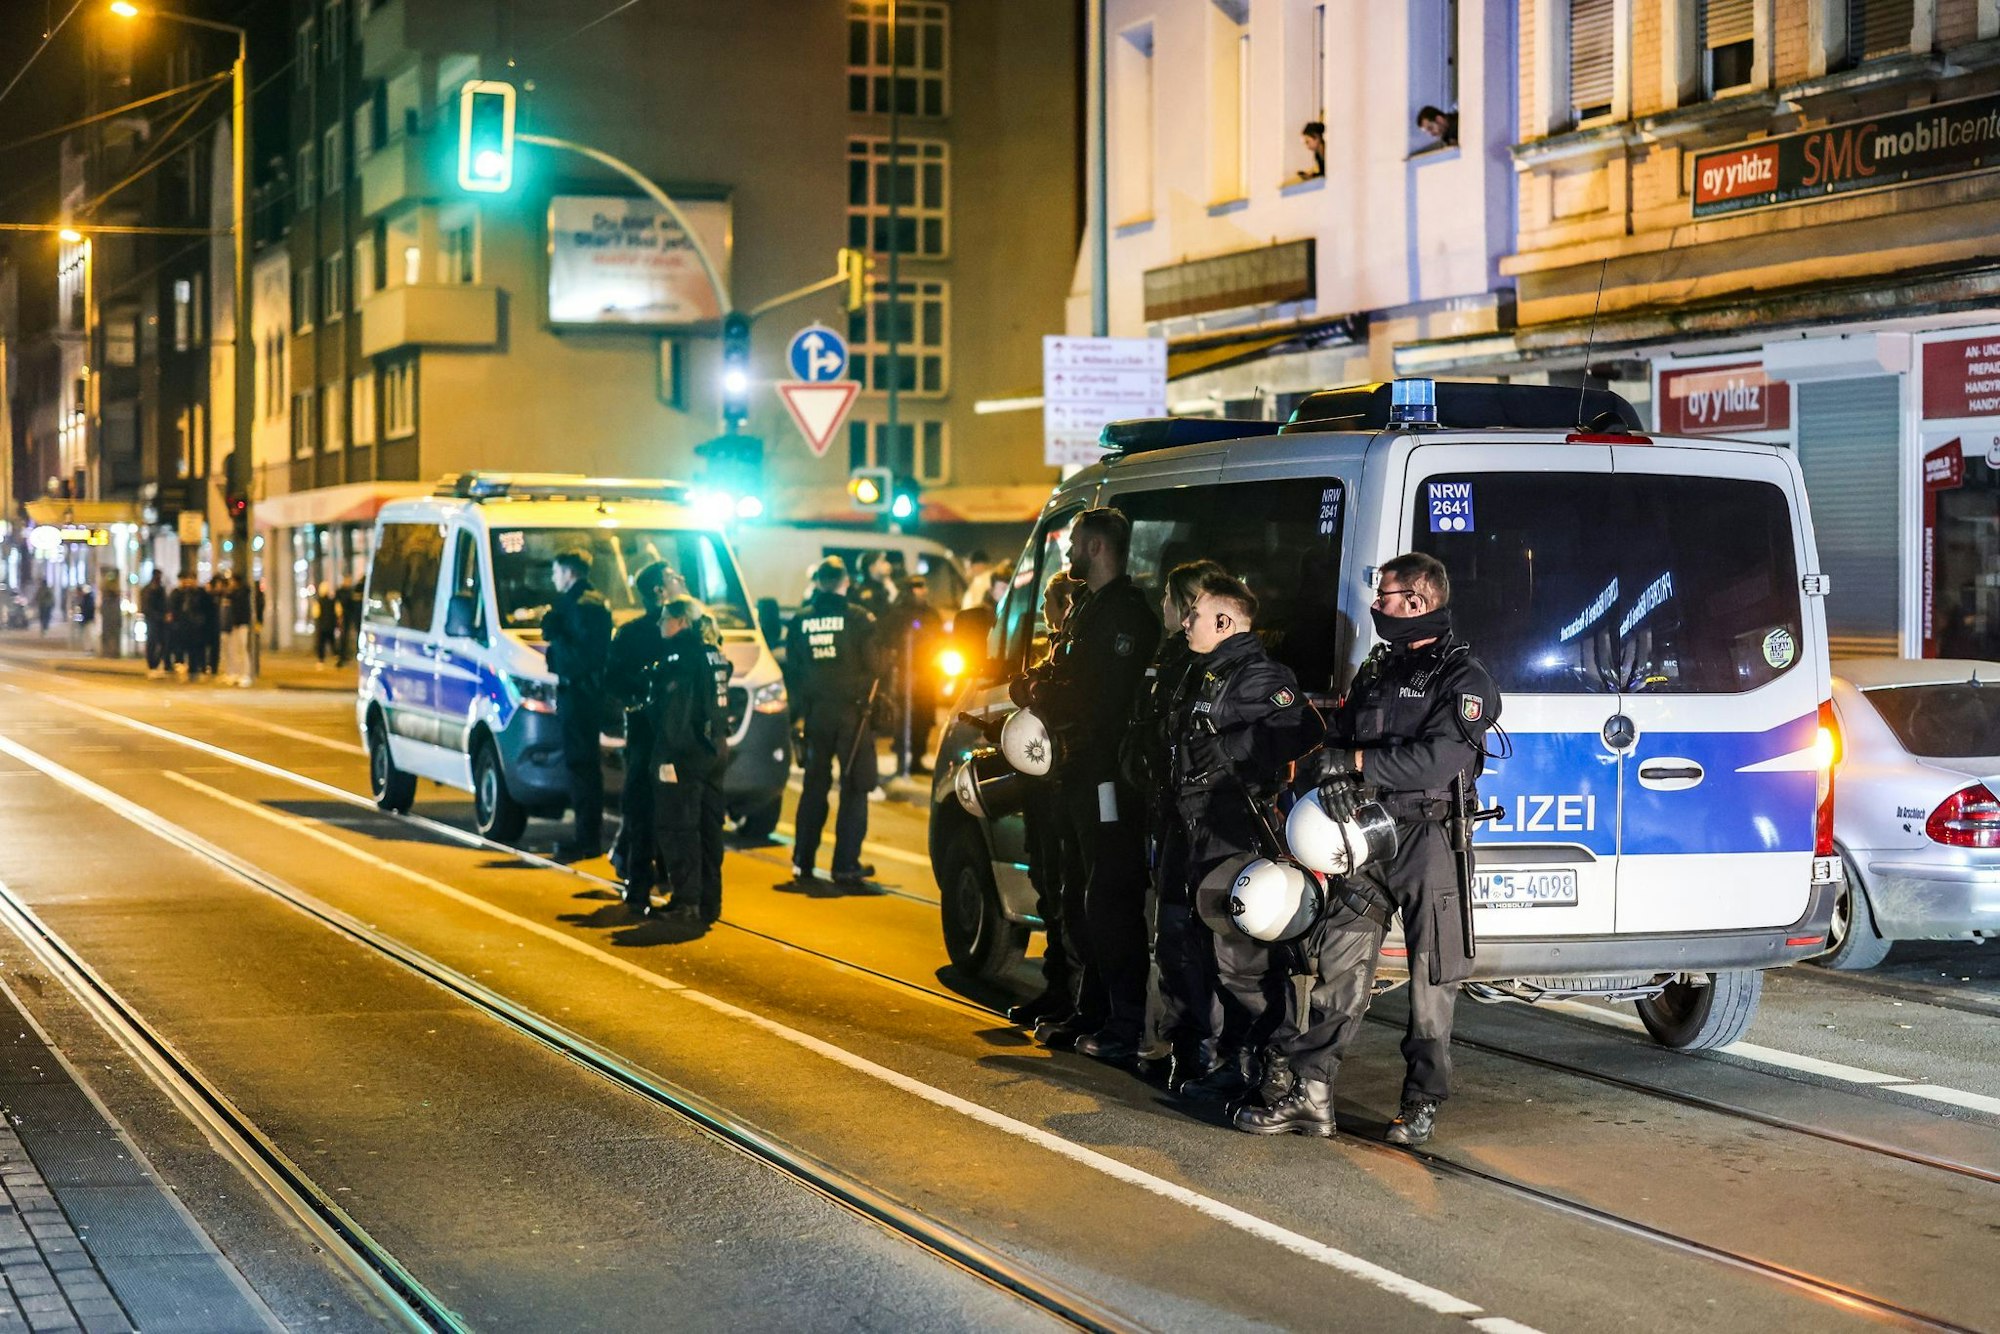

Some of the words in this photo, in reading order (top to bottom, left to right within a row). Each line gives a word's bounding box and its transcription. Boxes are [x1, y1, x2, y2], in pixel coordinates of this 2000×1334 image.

[1703, 167, 1724, 196] ay
[1802, 124, 1878, 186] SMC
[1689, 389, 1709, 423] ay
[1969, 397, 2000, 411] HANDY
[1322, 488, 1341, 502] NRW
[1430, 484, 1470, 499] NRW
[1320, 504, 1337, 519] 2641
[1432, 501, 1469, 515] 2641
[802, 616, 844, 634] POLIZEI
[1503, 875, 1574, 899] 5-4098
